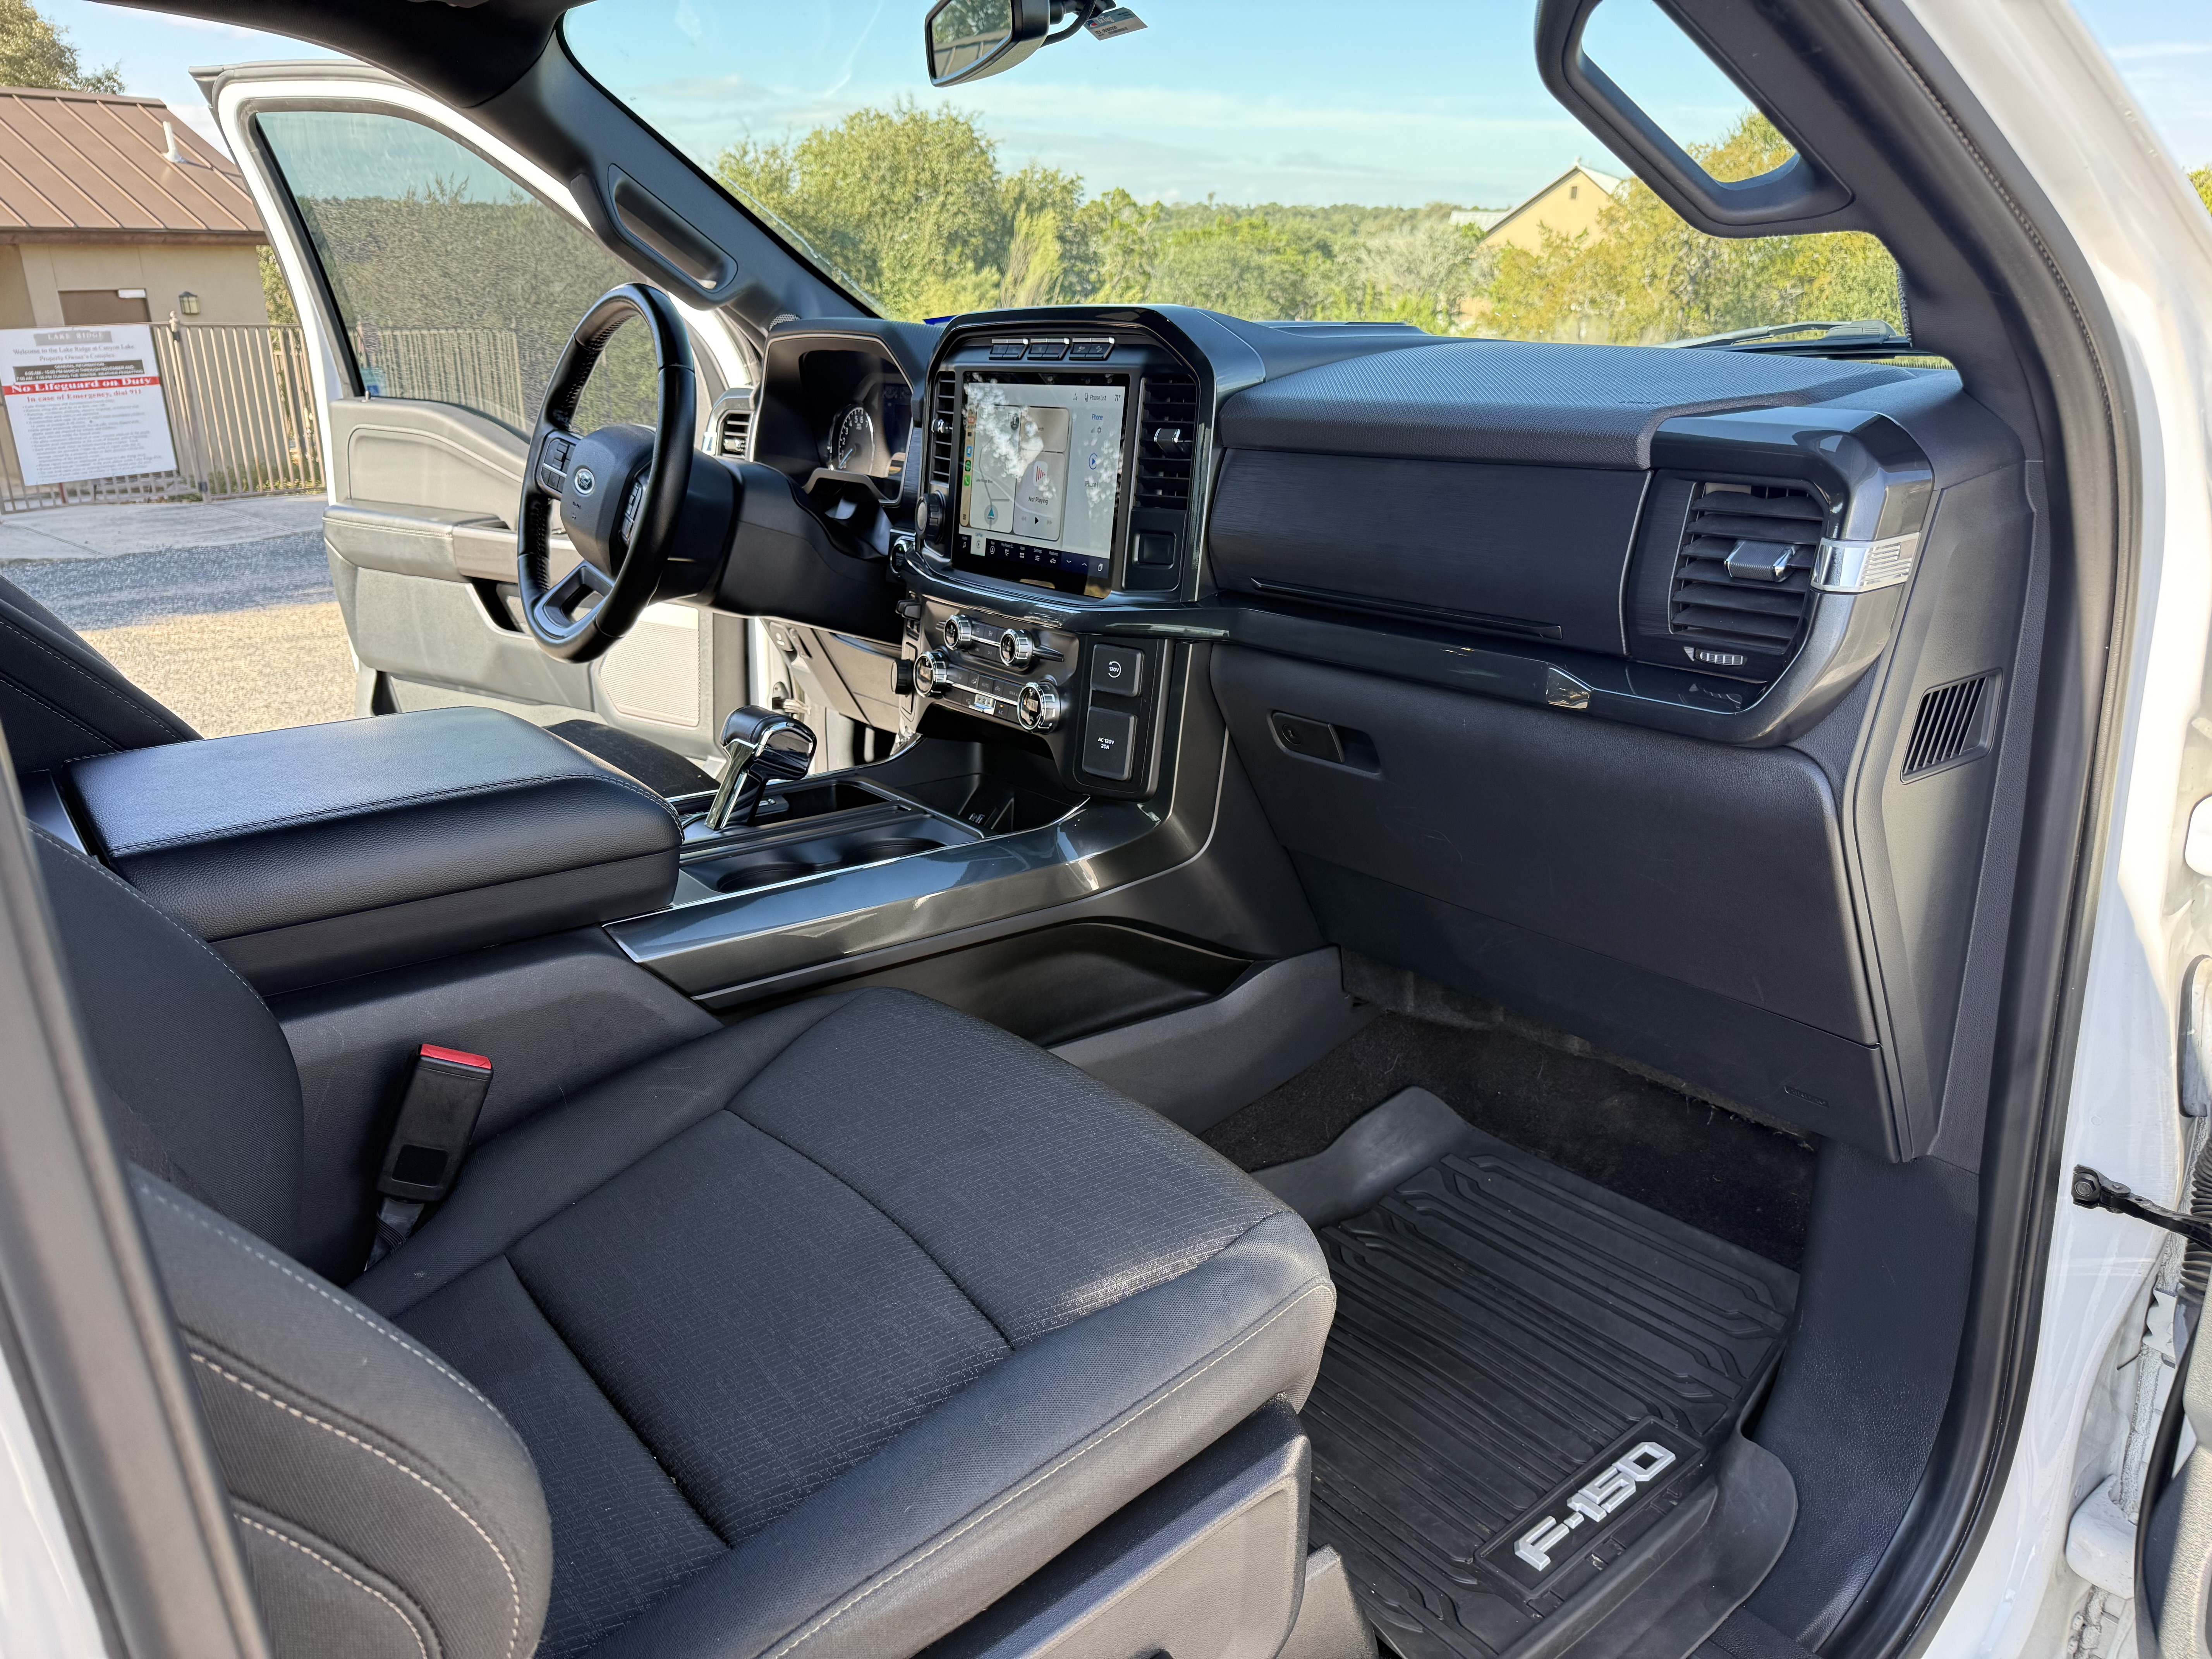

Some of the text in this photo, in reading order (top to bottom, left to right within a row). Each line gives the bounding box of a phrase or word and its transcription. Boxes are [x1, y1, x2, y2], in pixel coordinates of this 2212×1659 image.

[10, 384, 30, 393] No
[34, 380, 100, 392] Lifeguard
[121, 376, 152, 386] Duty
[66, 391, 112, 401] Emergency,
[579, 474, 591, 489] Ford
[1035, 497, 1048, 505] Playing
[1514, 1442, 1676, 1571] F-150
